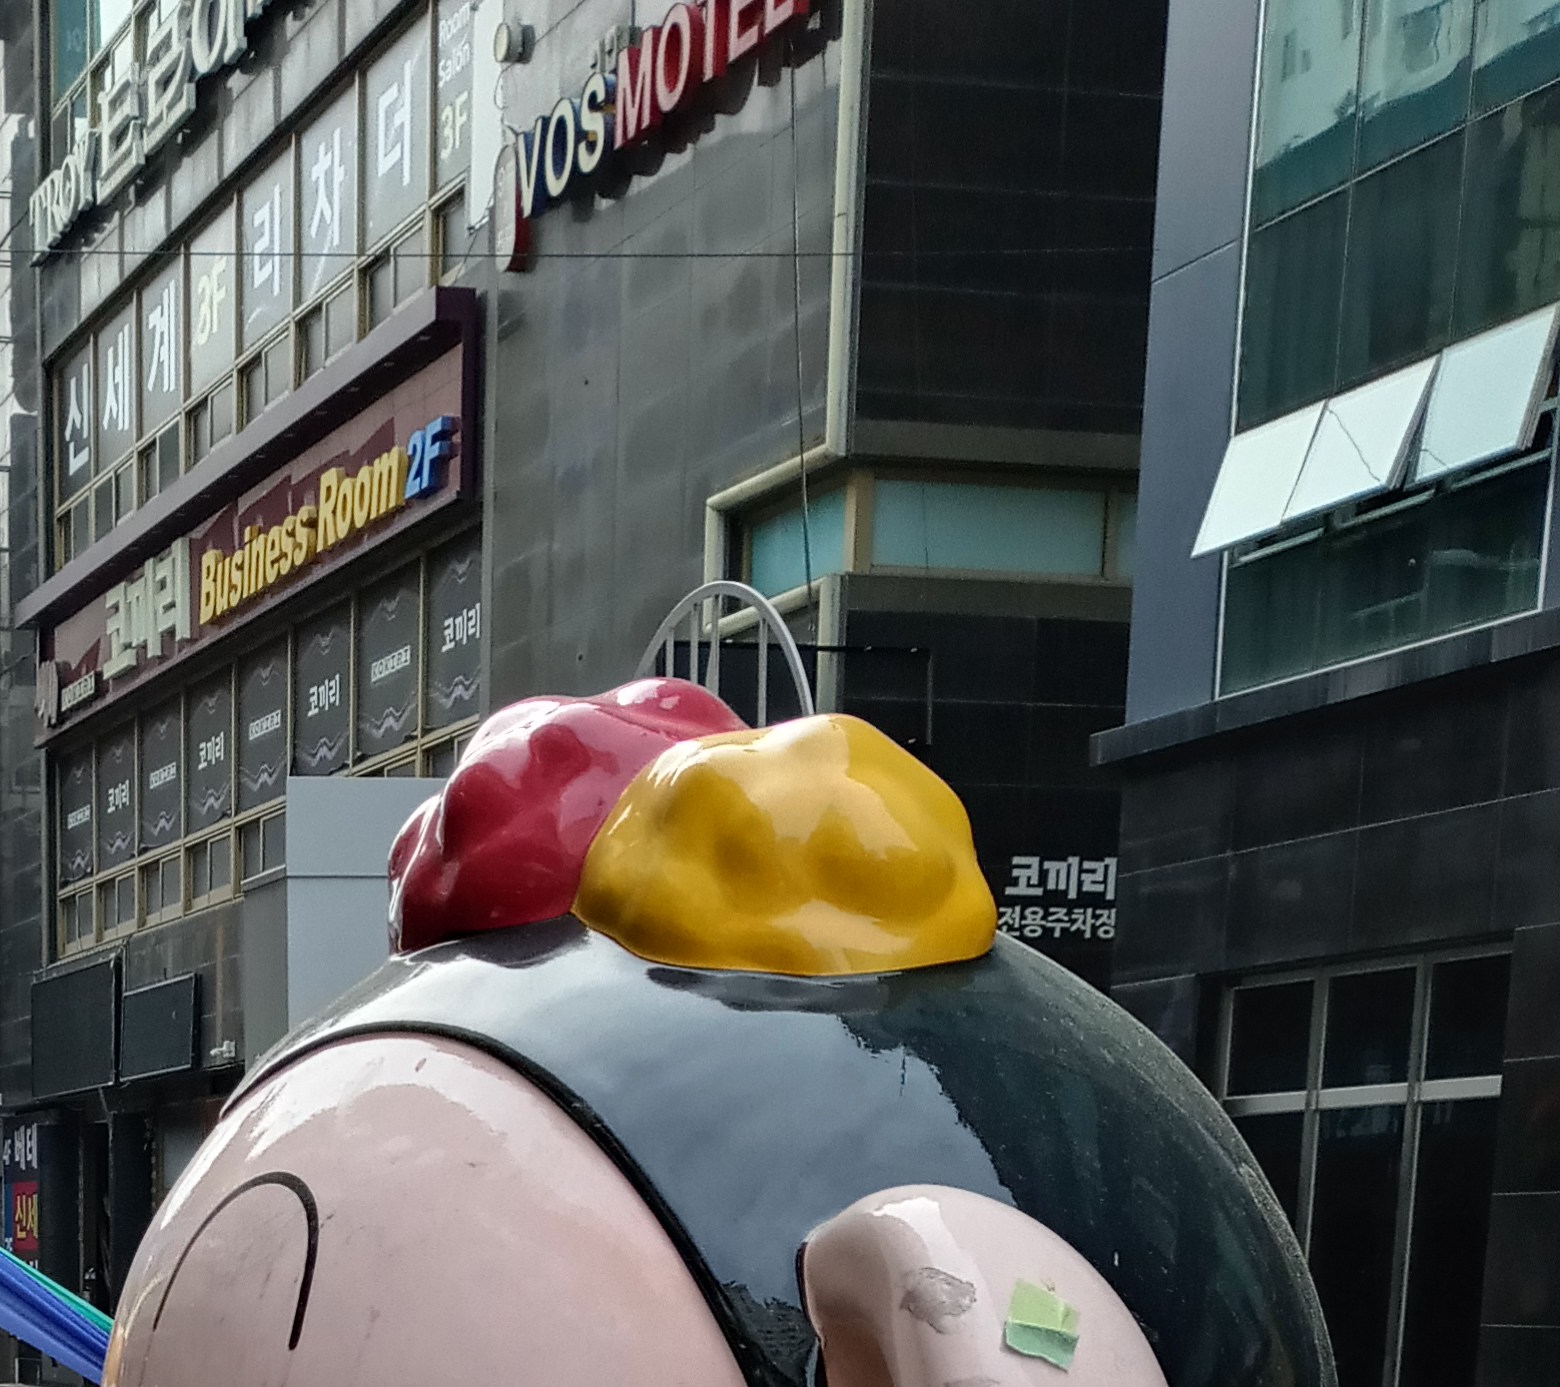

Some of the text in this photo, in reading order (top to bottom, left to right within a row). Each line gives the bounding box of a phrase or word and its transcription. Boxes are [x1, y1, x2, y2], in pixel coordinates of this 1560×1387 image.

[440, 91, 469, 160] 3F
[517, 72, 607, 218] VOS
[64, 255, 228, 478] 신세계 3F
[199, 416, 460, 626] Business Room 2F
[102, 536, 194, 682] 코끼리
[1004, 855, 1119, 901] 코끼리
